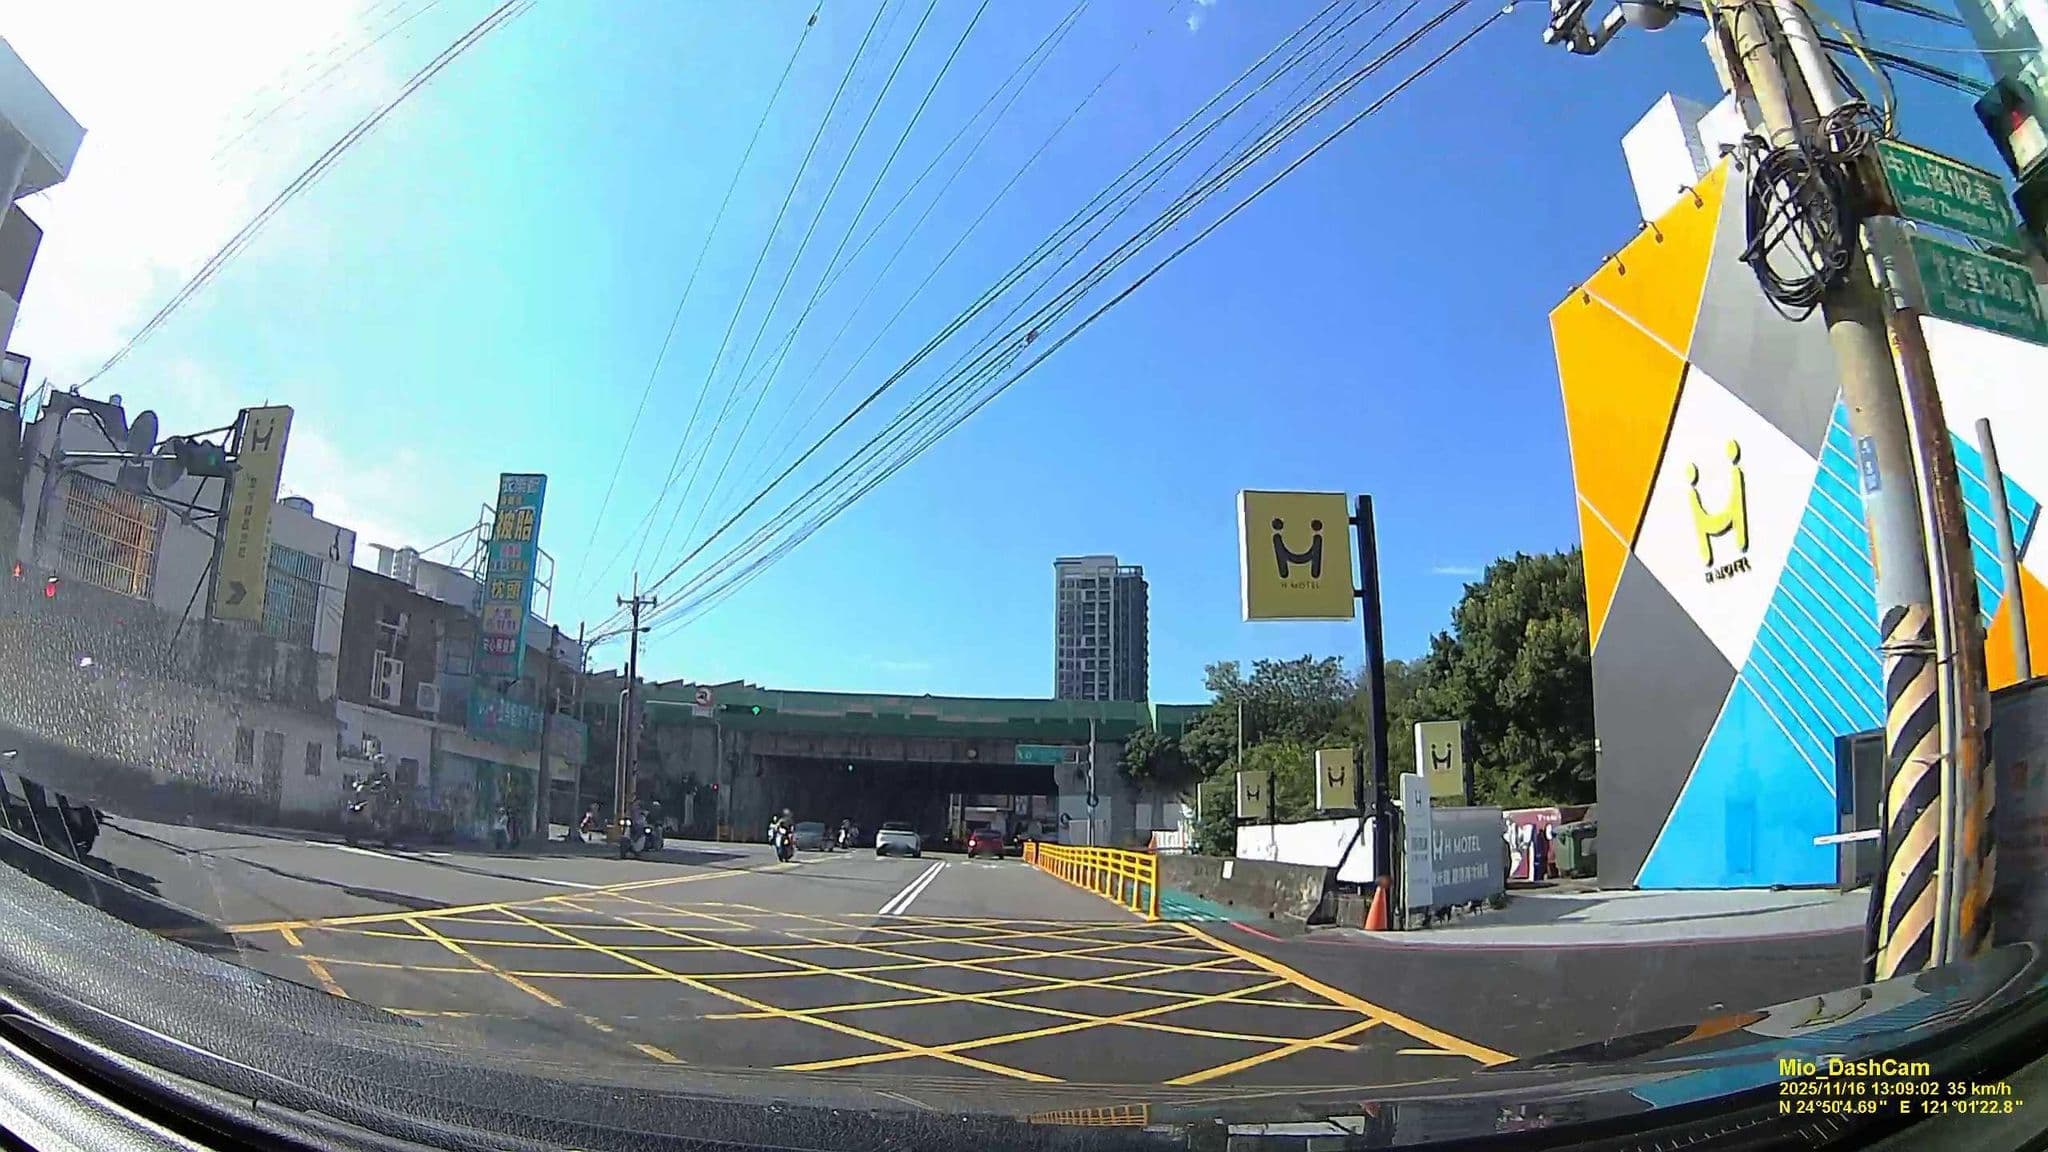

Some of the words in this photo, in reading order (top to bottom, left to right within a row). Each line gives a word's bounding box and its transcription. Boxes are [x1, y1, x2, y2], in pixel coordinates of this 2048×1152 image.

[1291, 581, 1320, 590] MOTEL
[1444, 838, 1451, 854] H
[1453, 835, 1481, 854] MOTEL
